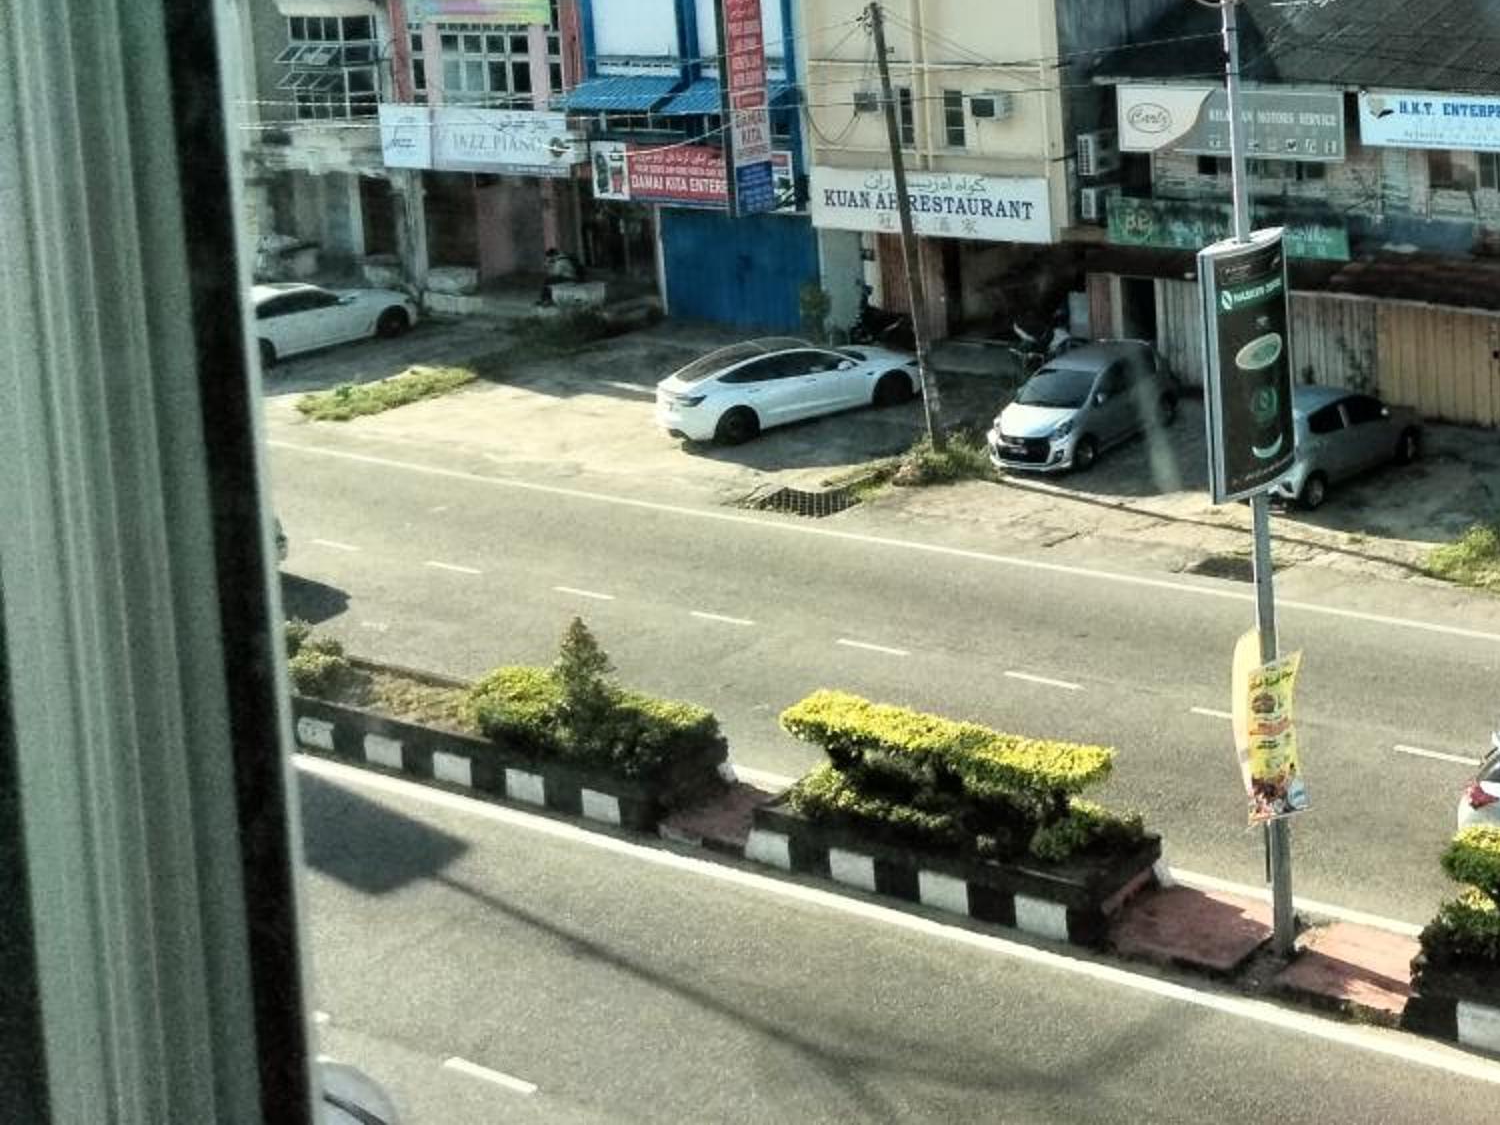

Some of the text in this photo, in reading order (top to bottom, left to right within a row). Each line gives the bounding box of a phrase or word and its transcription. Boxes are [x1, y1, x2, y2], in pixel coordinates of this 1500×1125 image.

[1257, 111, 1295, 124] MOTORS
[1299, 112, 1337, 126] SERVICE
[631, 174, 663, 190] DAMAI
[665, 176, 688, 192] KITA
[824, 189, 871, 209] KUAN
[906, 195, 1034, 220] RESTAURANT
